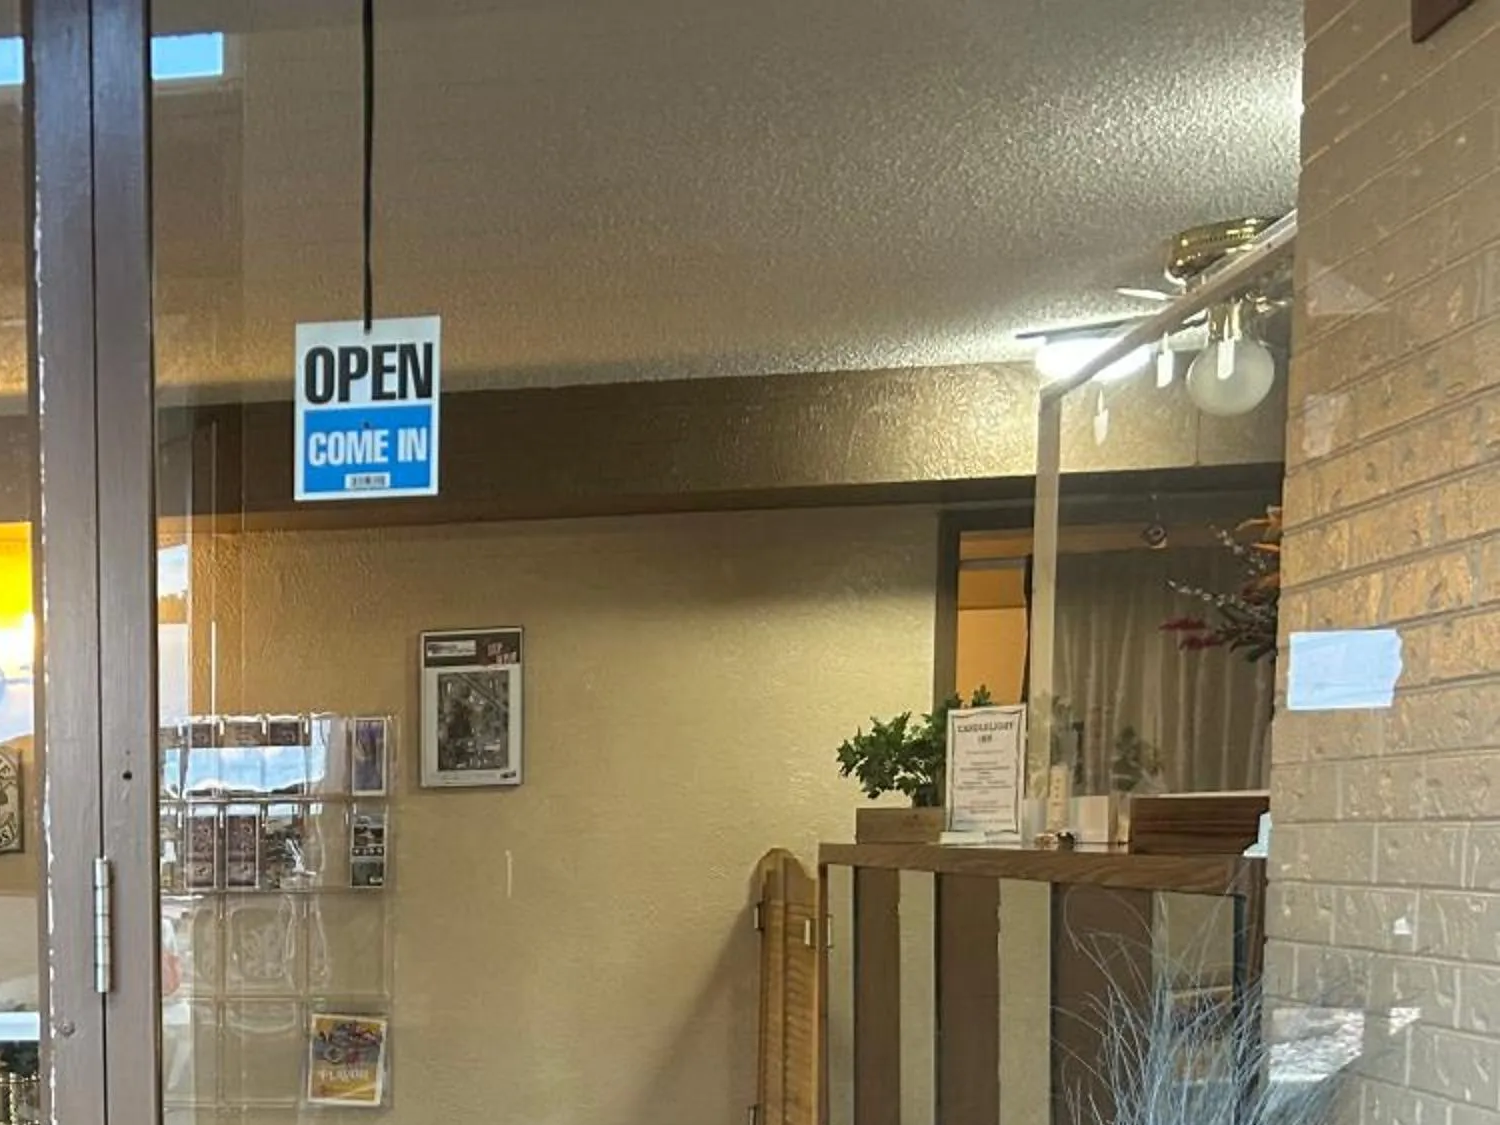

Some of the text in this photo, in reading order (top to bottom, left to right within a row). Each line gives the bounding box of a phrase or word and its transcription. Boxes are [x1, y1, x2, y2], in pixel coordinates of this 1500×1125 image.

[304, 342, 433, 405] OPEN
[308, 425, 428, 467] COME IN
